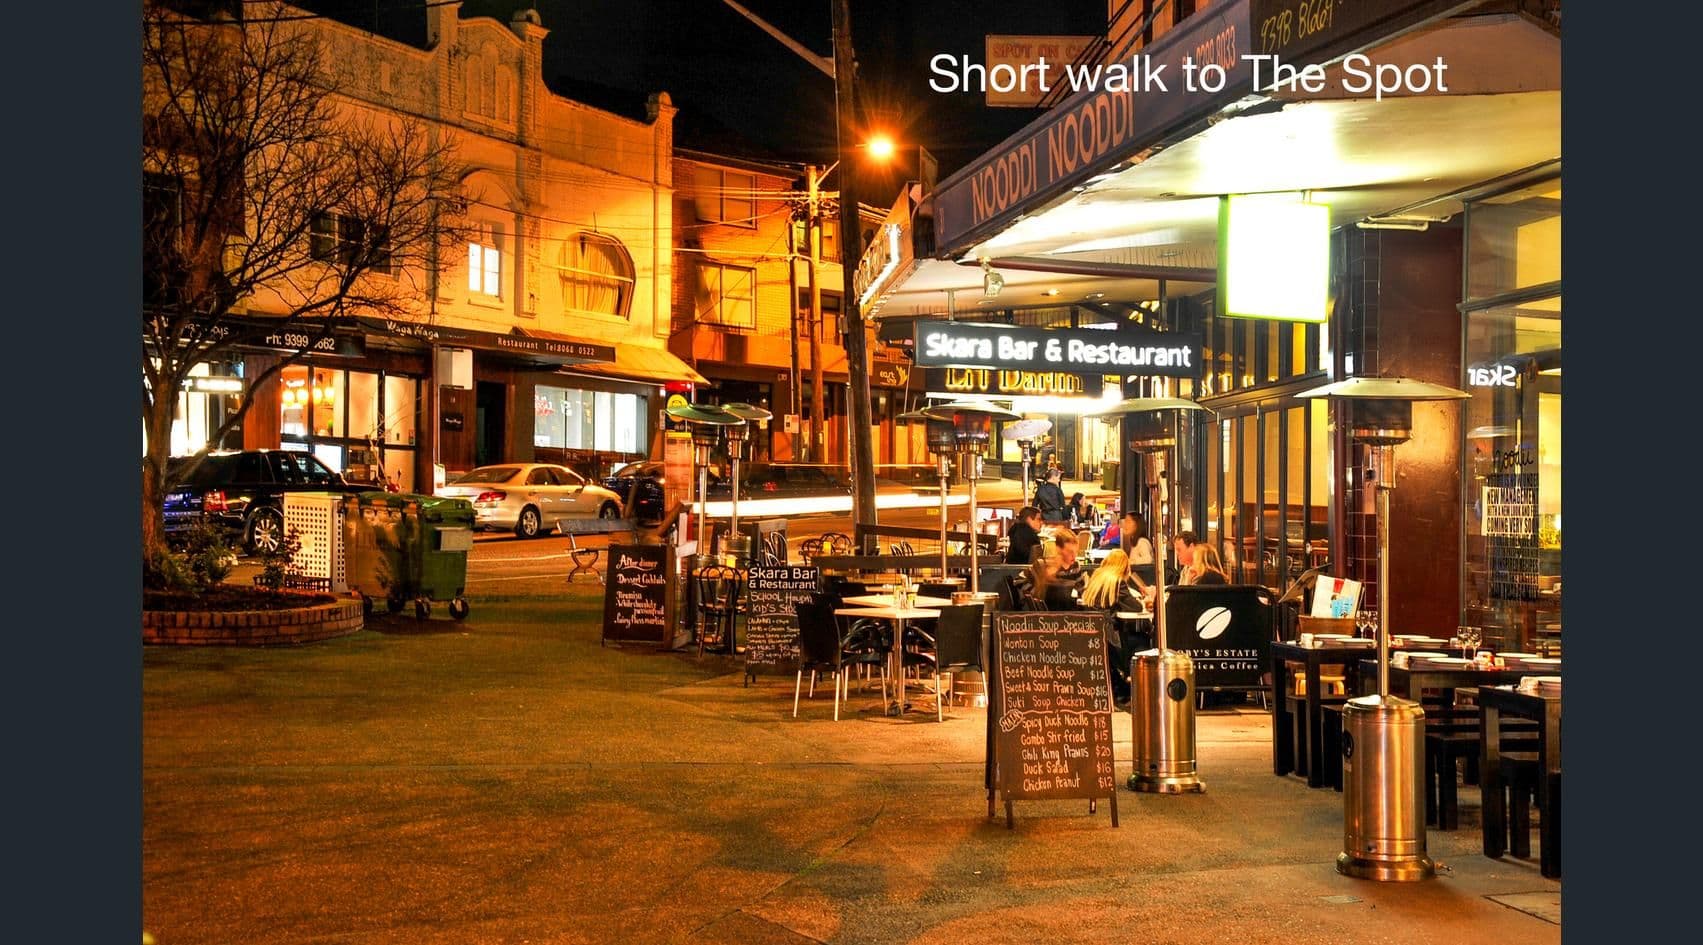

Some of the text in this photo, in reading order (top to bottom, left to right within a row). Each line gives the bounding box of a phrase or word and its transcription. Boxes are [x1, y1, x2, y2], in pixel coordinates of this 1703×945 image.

[993, 43, 1032, 58] SPOT
[1037, 44, 1059, 58] ON
[971, 77, 1135, 225] NOODDI NOODDI
[284, 333, 309, 347] 9399
[497, 336, 539, 350] Restaurant
[926, 332, 1192, 367] Skara Bar & Restaurant
[1487, 488, 1499, 505] NEW
[1487, 517, 1508, 532] COMING
[1509, 517, 1523, 533] VERY
[749, 568, 816, 580] Skara Bar
[749, 580, 816, 590] & Restaurant
[753, 603, 776, 614] KID'S
[1039, 617, 1059, 636] Soup
[1063, 616, 1096, 635] Specials
[1039, 635, 1059, 652] Soup
[1088, 638, 1100, 649] $8
[1003, 651, 1103, 669] Chicken Noodle Soup $12
[1177, 649, 1258, 657] OBY'S ESTATE
[1005, 665, 1105, 681] Beef Noodle Soup $12
[1220, 662, 1258, 670] Coffee
[1032, 680, 1049, 692] Sour
[1053, 680, 1074, 695] Prawn
[1077, 682, 1095, 697] Soup
[1007, 695, 1108, 710] Suki Soup Chicken $12
[1022, 717, 1042, 733] Spicy
[1044, 713, 1062, 727] Duck
[1093, 716, 1107, 729] $18
[1047, 731, 1062, 743] Stir
[1063, 728, 1086, 743] fried
[1094, 730, 1109, 742] $15
[1041, 746, 1060, 763] King
[1063, 743, 1090, 758] Prawns
[1095, 745, 1111, 758] $20
[1023, 760, 1111, 775] Duck Salad $16
[1023, 771, 1113, 792] Chicken Peanut $12
